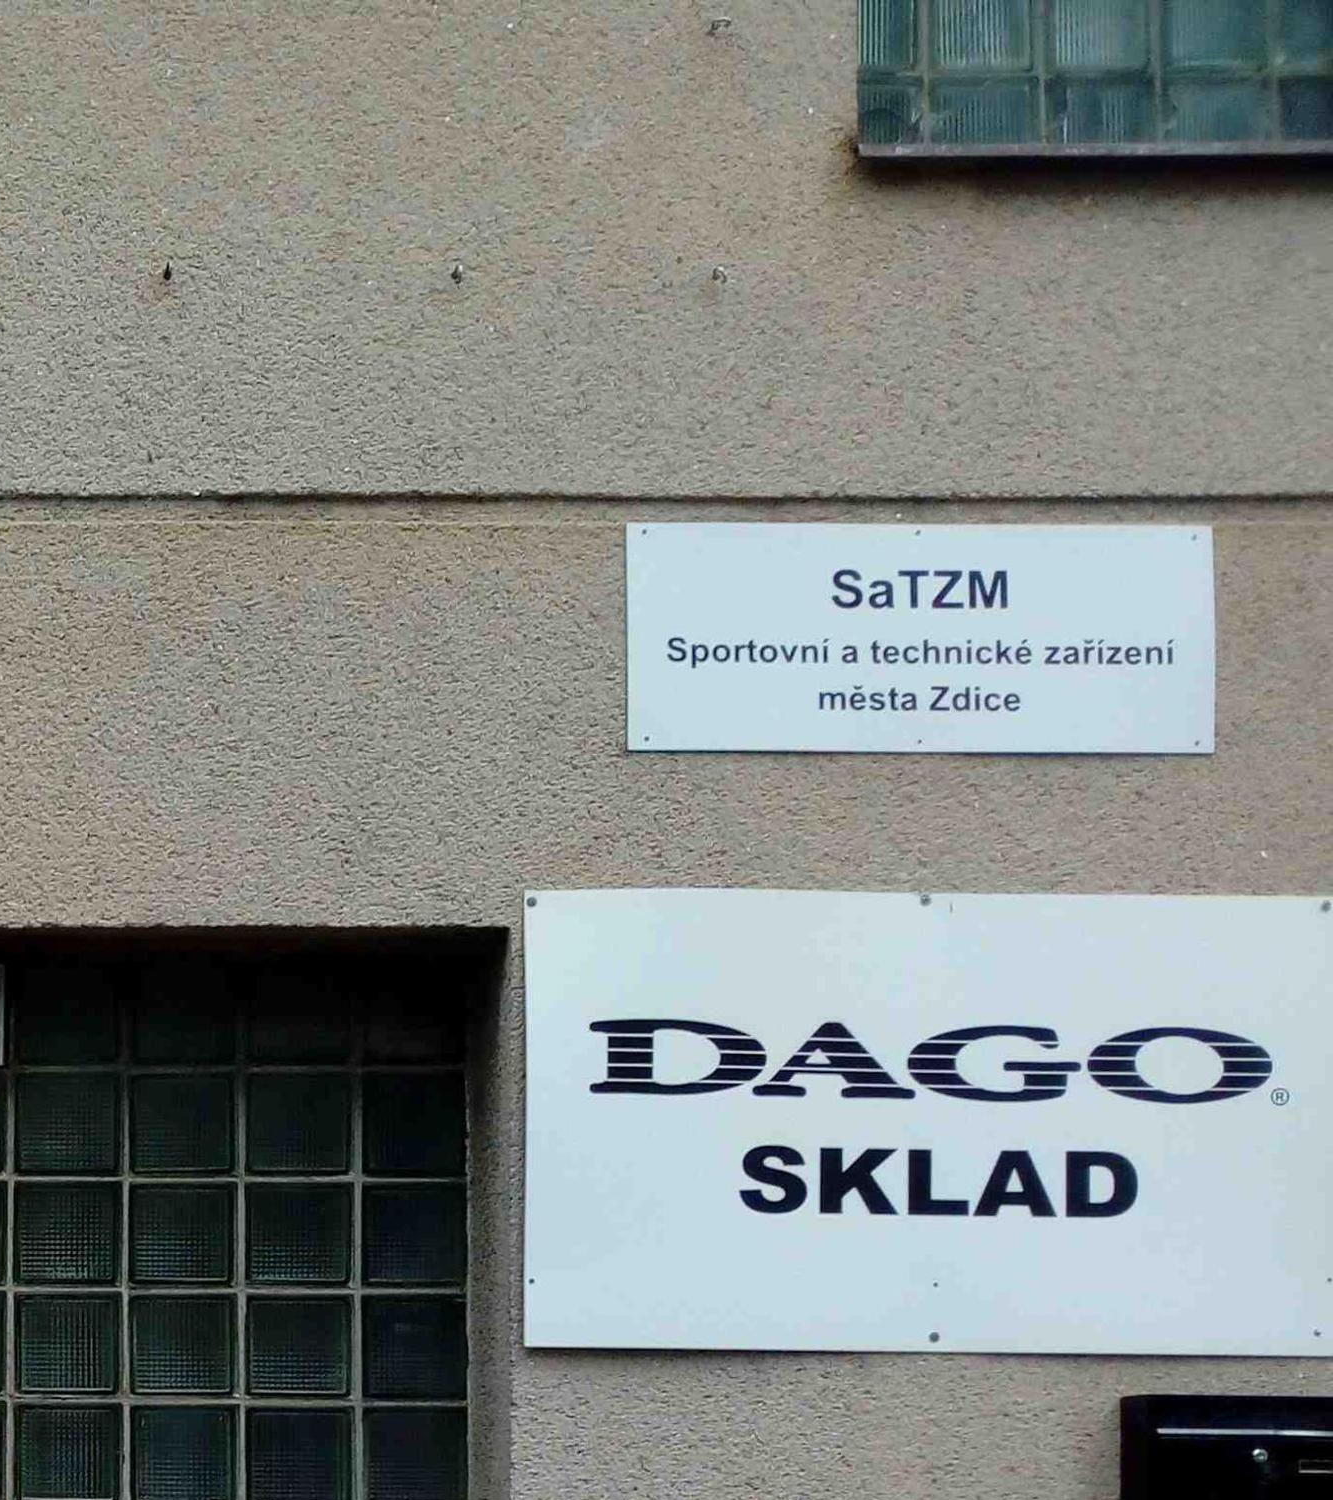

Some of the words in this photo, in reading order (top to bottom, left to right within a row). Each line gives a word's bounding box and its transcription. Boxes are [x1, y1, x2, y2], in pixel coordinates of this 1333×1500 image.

[832, 569, 1008, 609] SaTZM
[667, 637, 829, 669] Sportovní
[841, 645, 858, 664] a
[870, 639, 1032, 665] technické
[1044, 639, 1174, 666] zařízení
[819, 685, 918, 712] města
[929, 686, 1021, 712] Zdice
[589, 1018, 1273, 1104] DAGO
[739, 1145, 1138, 1218] SKLAD
